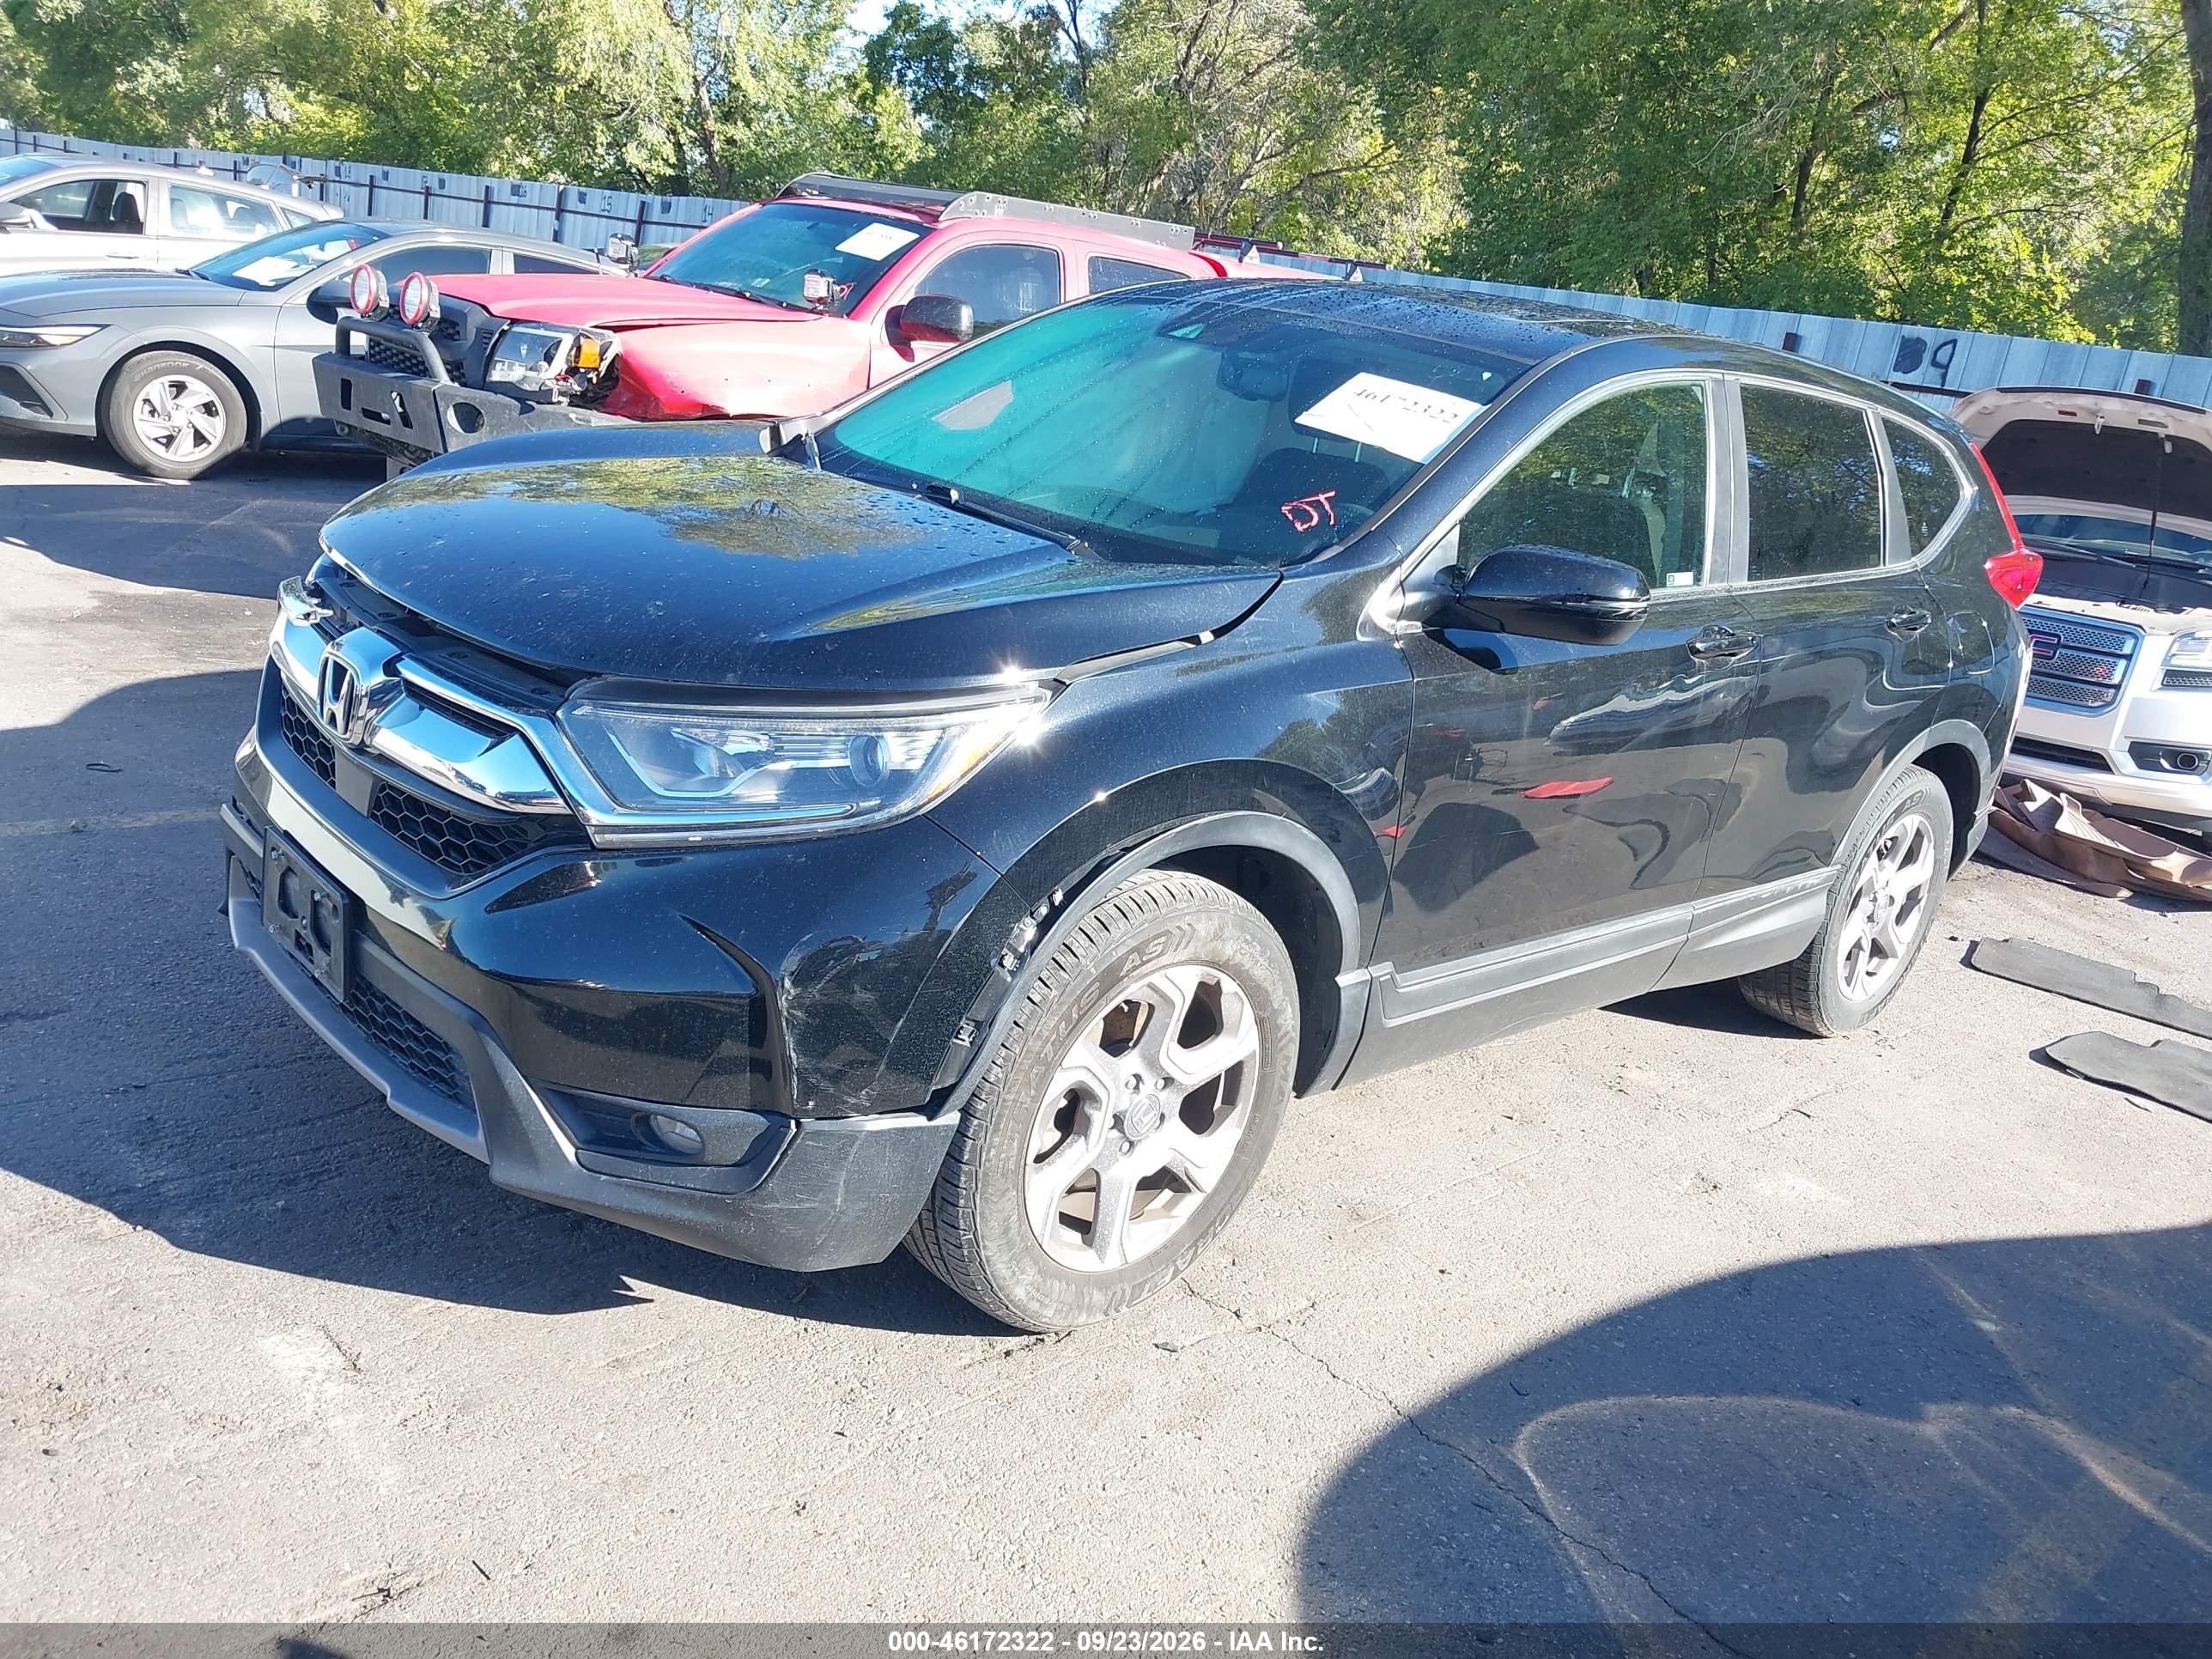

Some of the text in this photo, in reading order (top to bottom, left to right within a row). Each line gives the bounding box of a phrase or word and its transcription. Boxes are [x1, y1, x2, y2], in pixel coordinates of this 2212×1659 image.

[601, 194, 612, 213] 15
[1280, 490, 1336, 532] DT
[1117, 934, 1169, 978] AS
